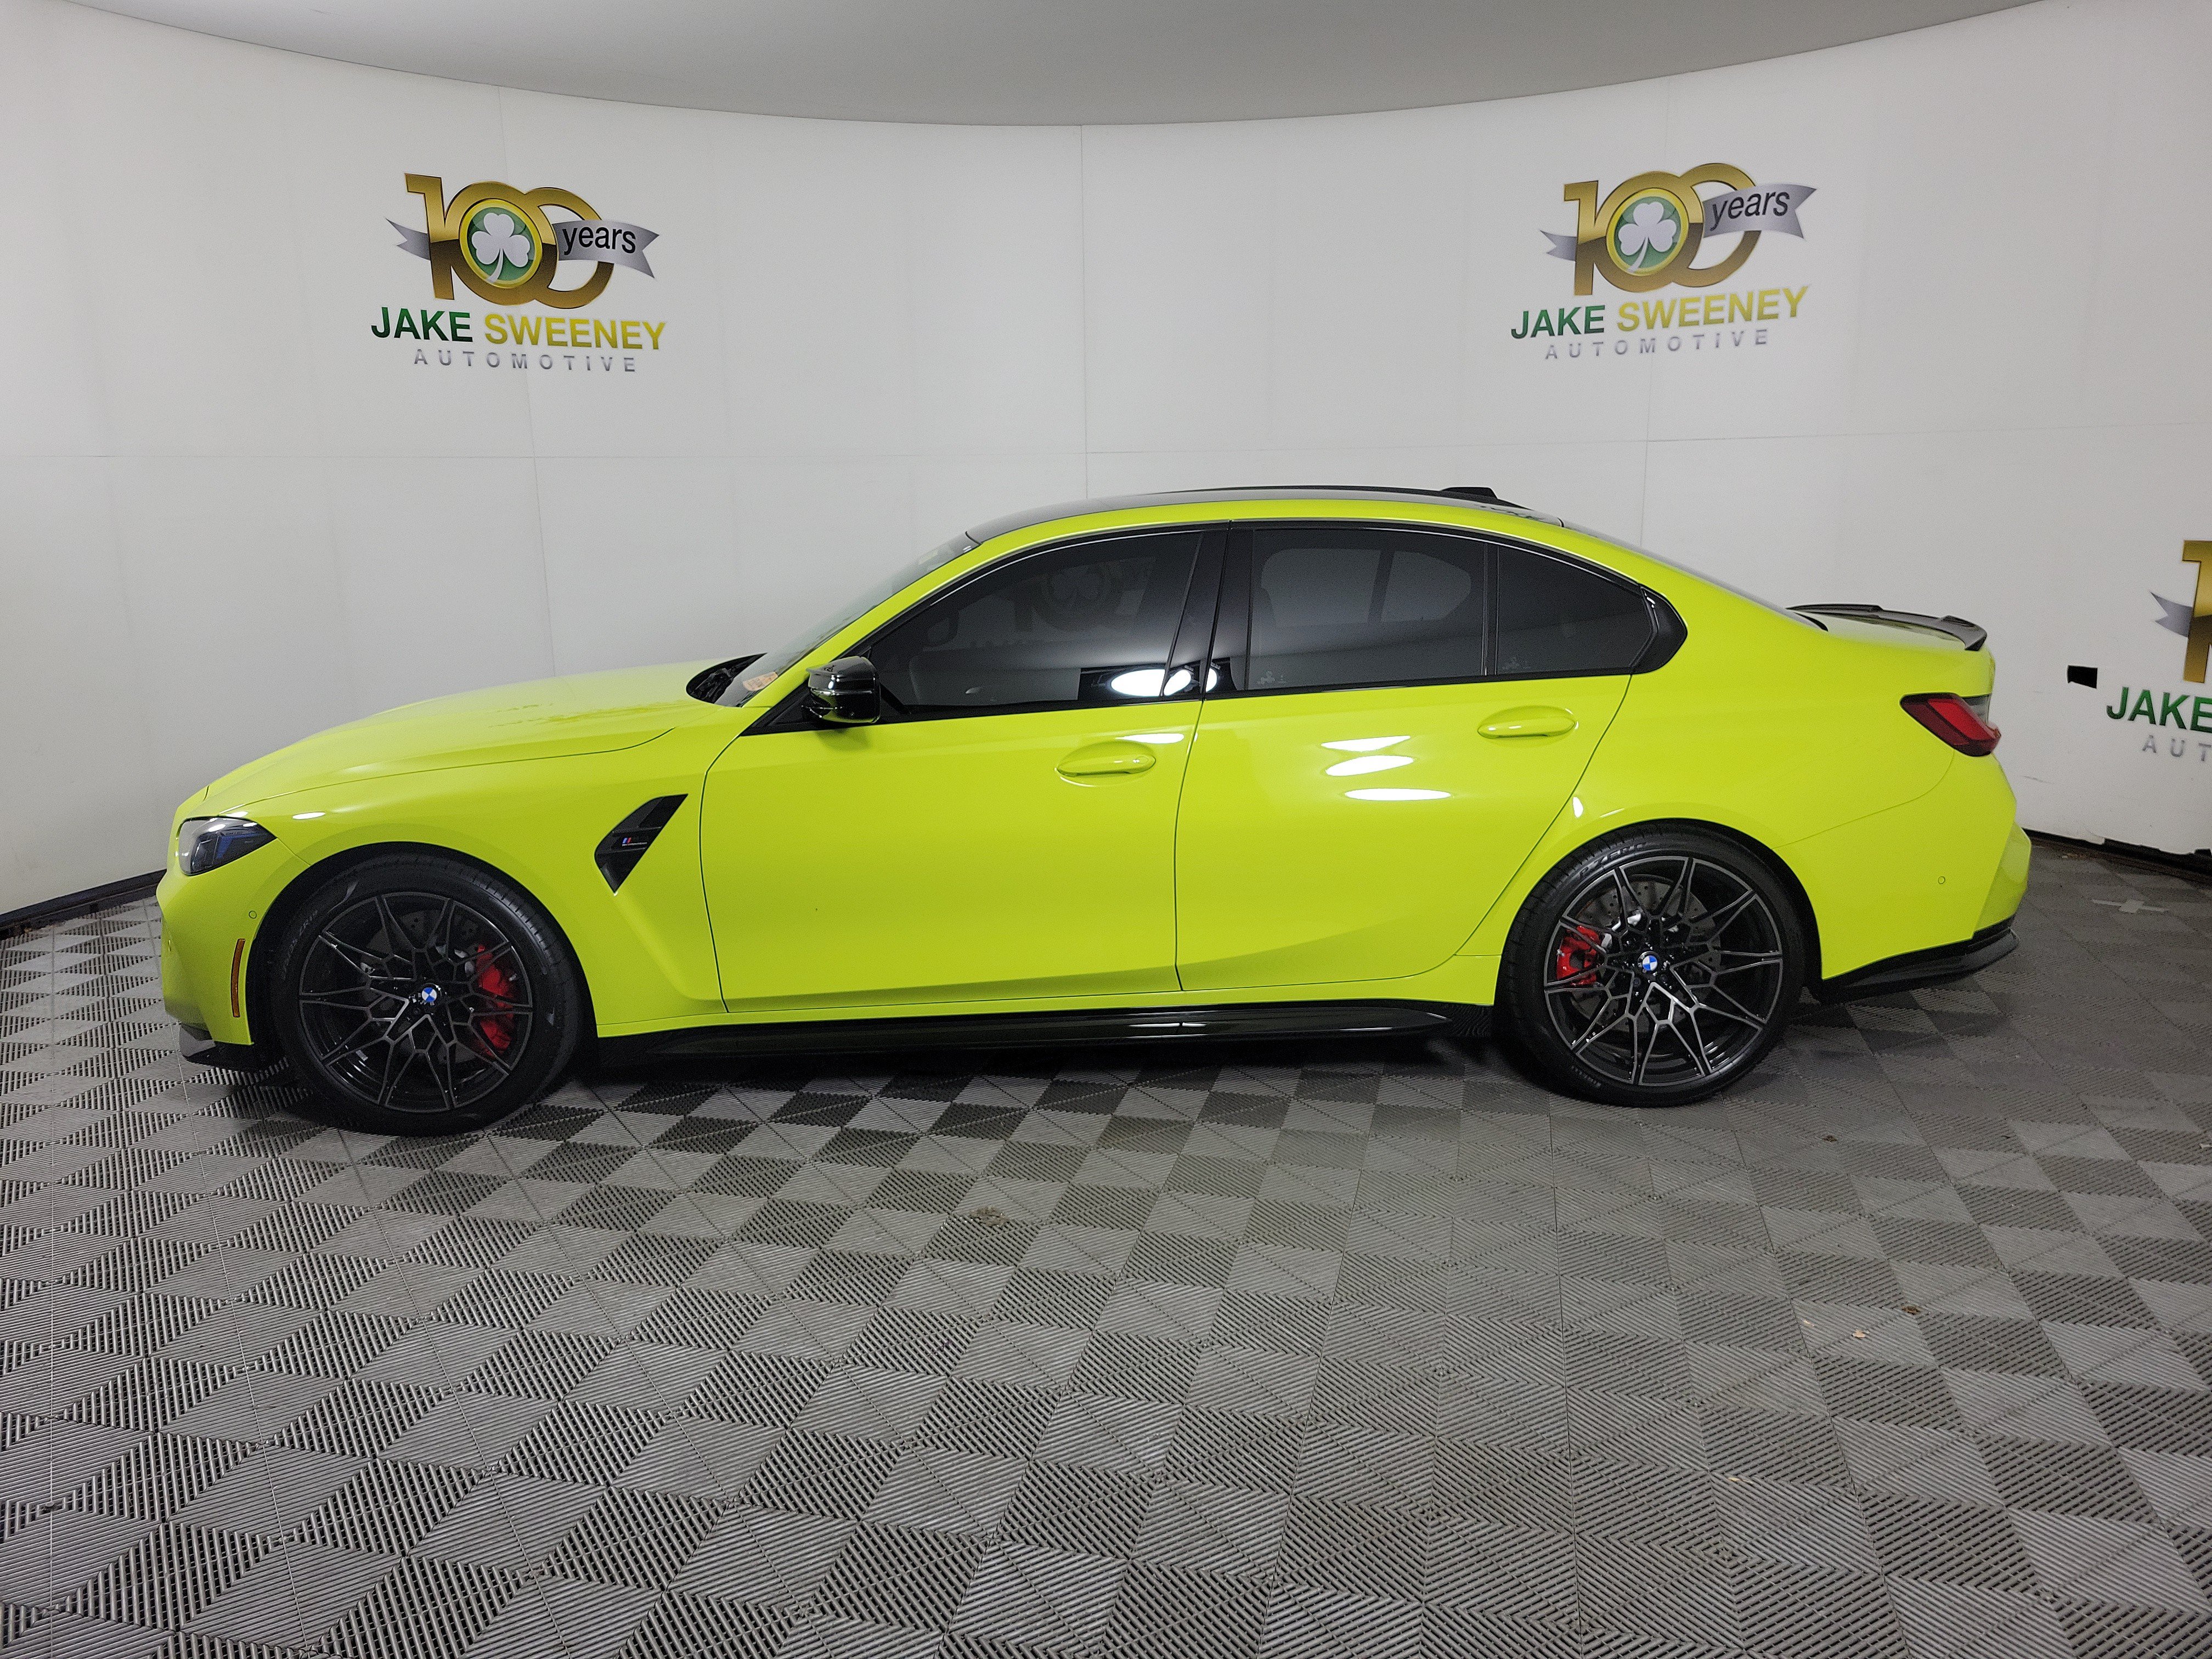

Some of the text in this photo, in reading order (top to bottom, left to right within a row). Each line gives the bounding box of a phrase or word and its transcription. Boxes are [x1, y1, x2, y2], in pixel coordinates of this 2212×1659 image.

[1710, 189, 1790, 230] years
[561, 226, 636, 256] years
[371, 306, 666, 350] JAKE SWEENEY
[1511, 286, 1808, 339] JAKE SWEENEY
[413, 348, 635, 372] AUTOMOTIVE
[1545, 329, 1768, 360] AUTOMOTIVE
[2106, 686, 2212, 734] JAKE
